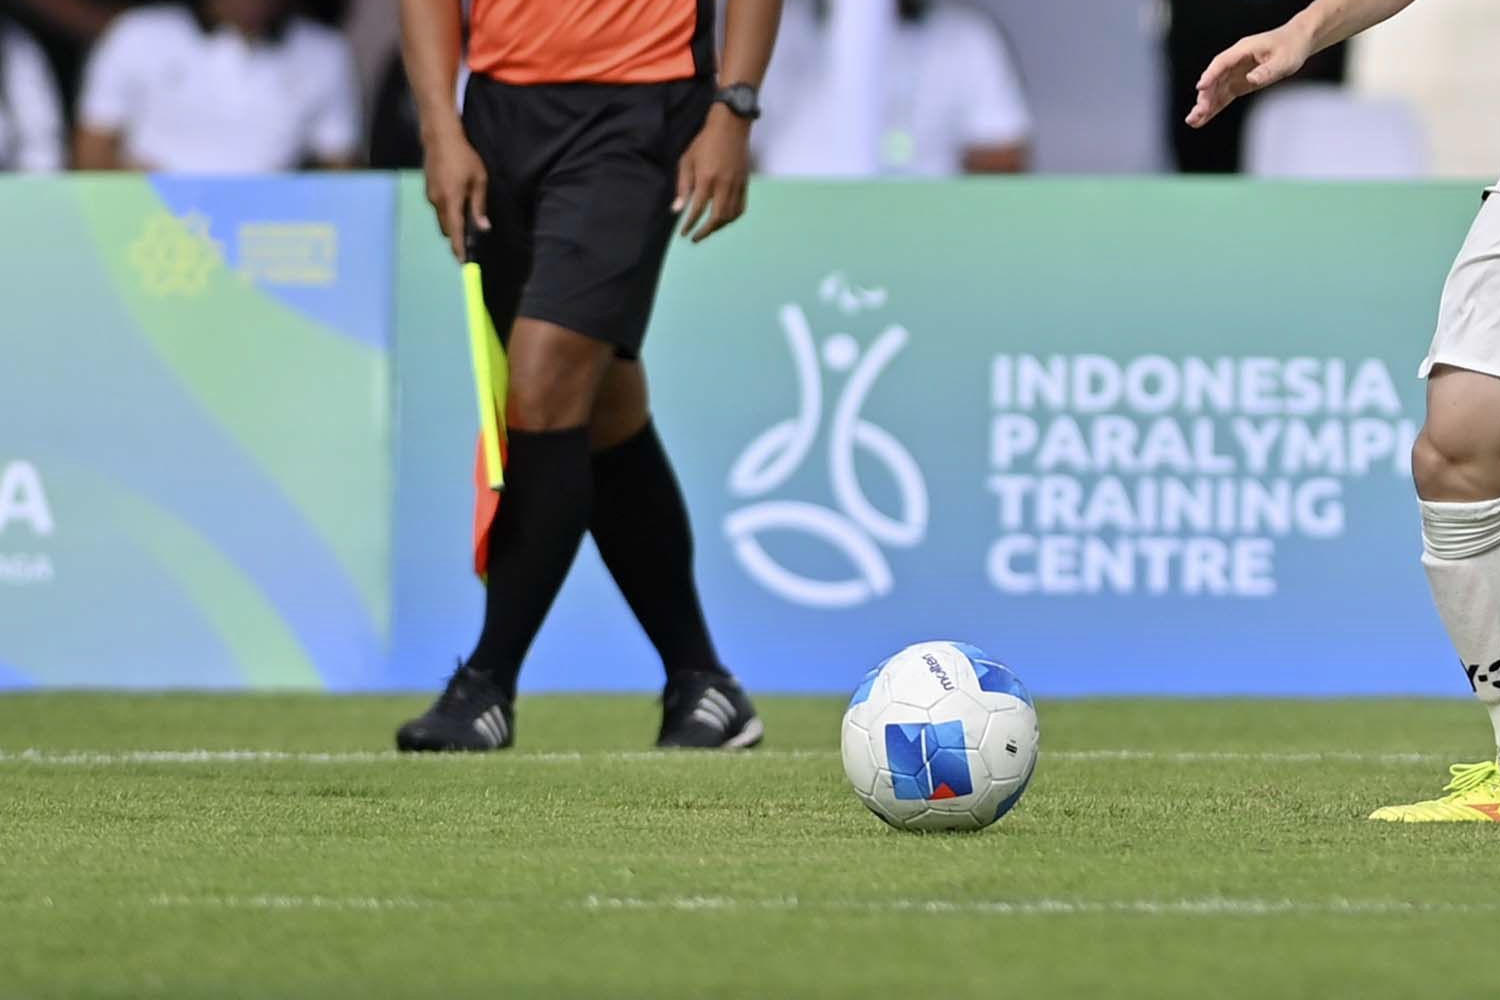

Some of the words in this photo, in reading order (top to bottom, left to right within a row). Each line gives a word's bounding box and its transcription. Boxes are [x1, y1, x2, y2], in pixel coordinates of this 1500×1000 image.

[990, 354, 1400, 413] INDONESIA
[989, 414, 1417, 475] PARALYMPI
[987, 475, 1345, 537] TRAINING
[986, 535, 1277, 596] CENTRE
